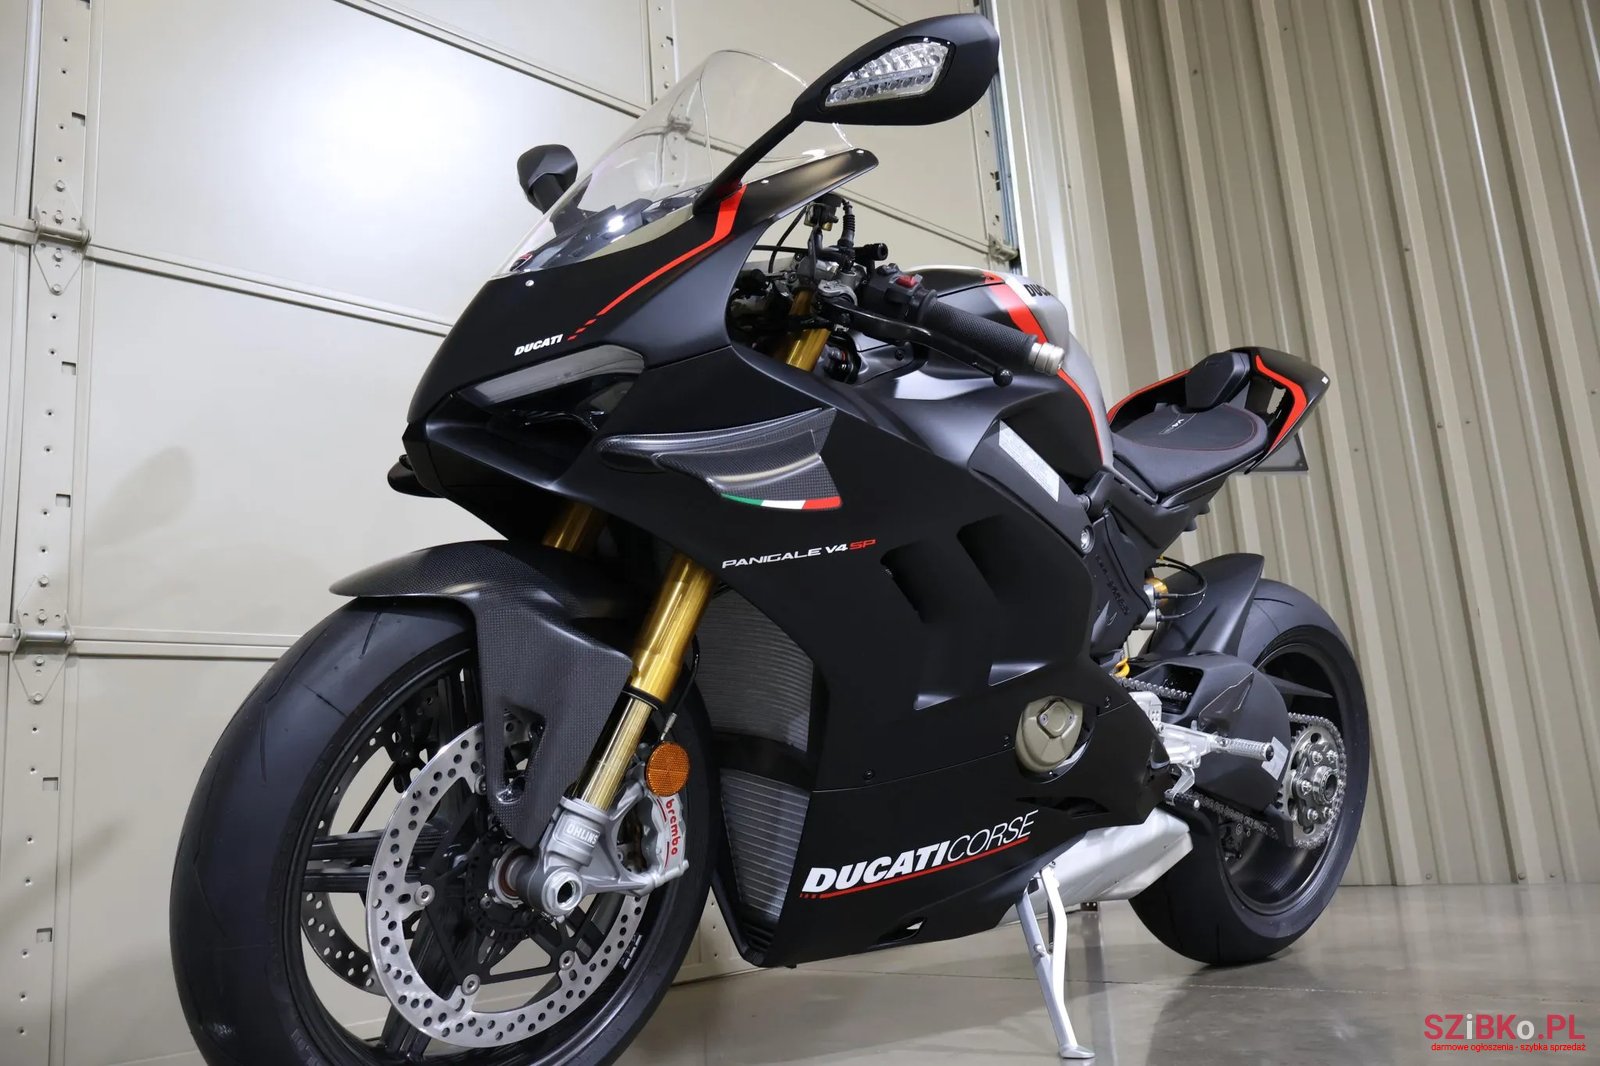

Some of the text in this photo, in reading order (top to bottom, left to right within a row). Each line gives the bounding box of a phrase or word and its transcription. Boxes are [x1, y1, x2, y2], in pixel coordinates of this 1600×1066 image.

[514, 333, 564, 356] DUCATI
[722, 548, 822, 569] PANIGALE
[665, 798, 681, 855] brembo
